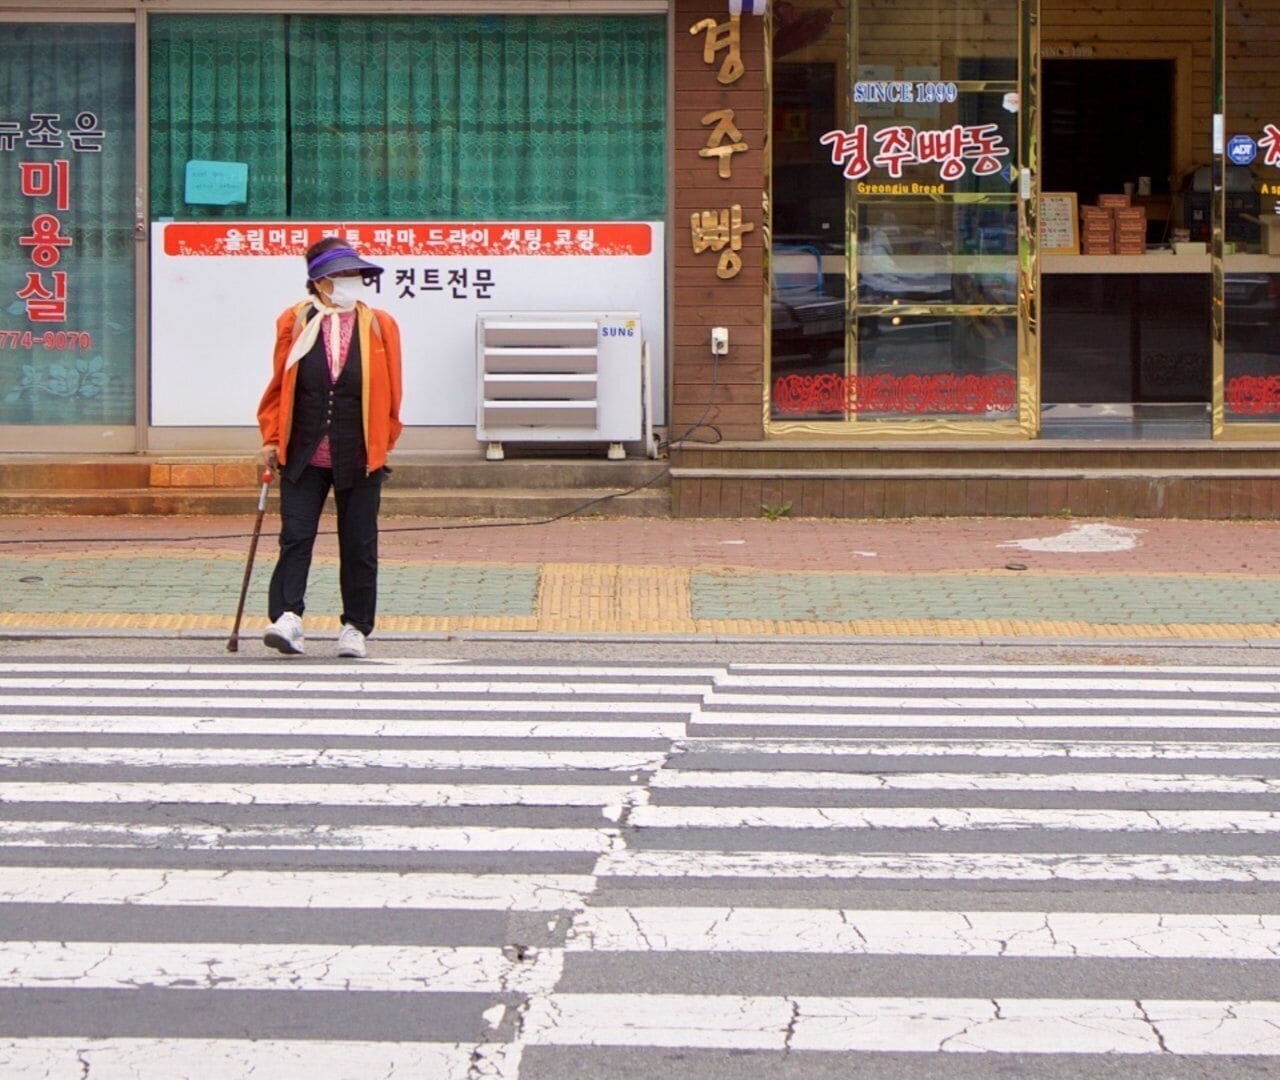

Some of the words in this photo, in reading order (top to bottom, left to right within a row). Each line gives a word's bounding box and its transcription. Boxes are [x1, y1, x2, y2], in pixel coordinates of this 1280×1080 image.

[854, 82, 913, 103] SINCE
[915, 82, 958, 103] 1999
[689, 18, 755, 279] 경주빵
[856, 182, 908, 195] Gyeongju
[911, 182, 945, 195] Bread
[1261, 183, 1269, 194] A
[17, 159, 72, 322] 미용실
